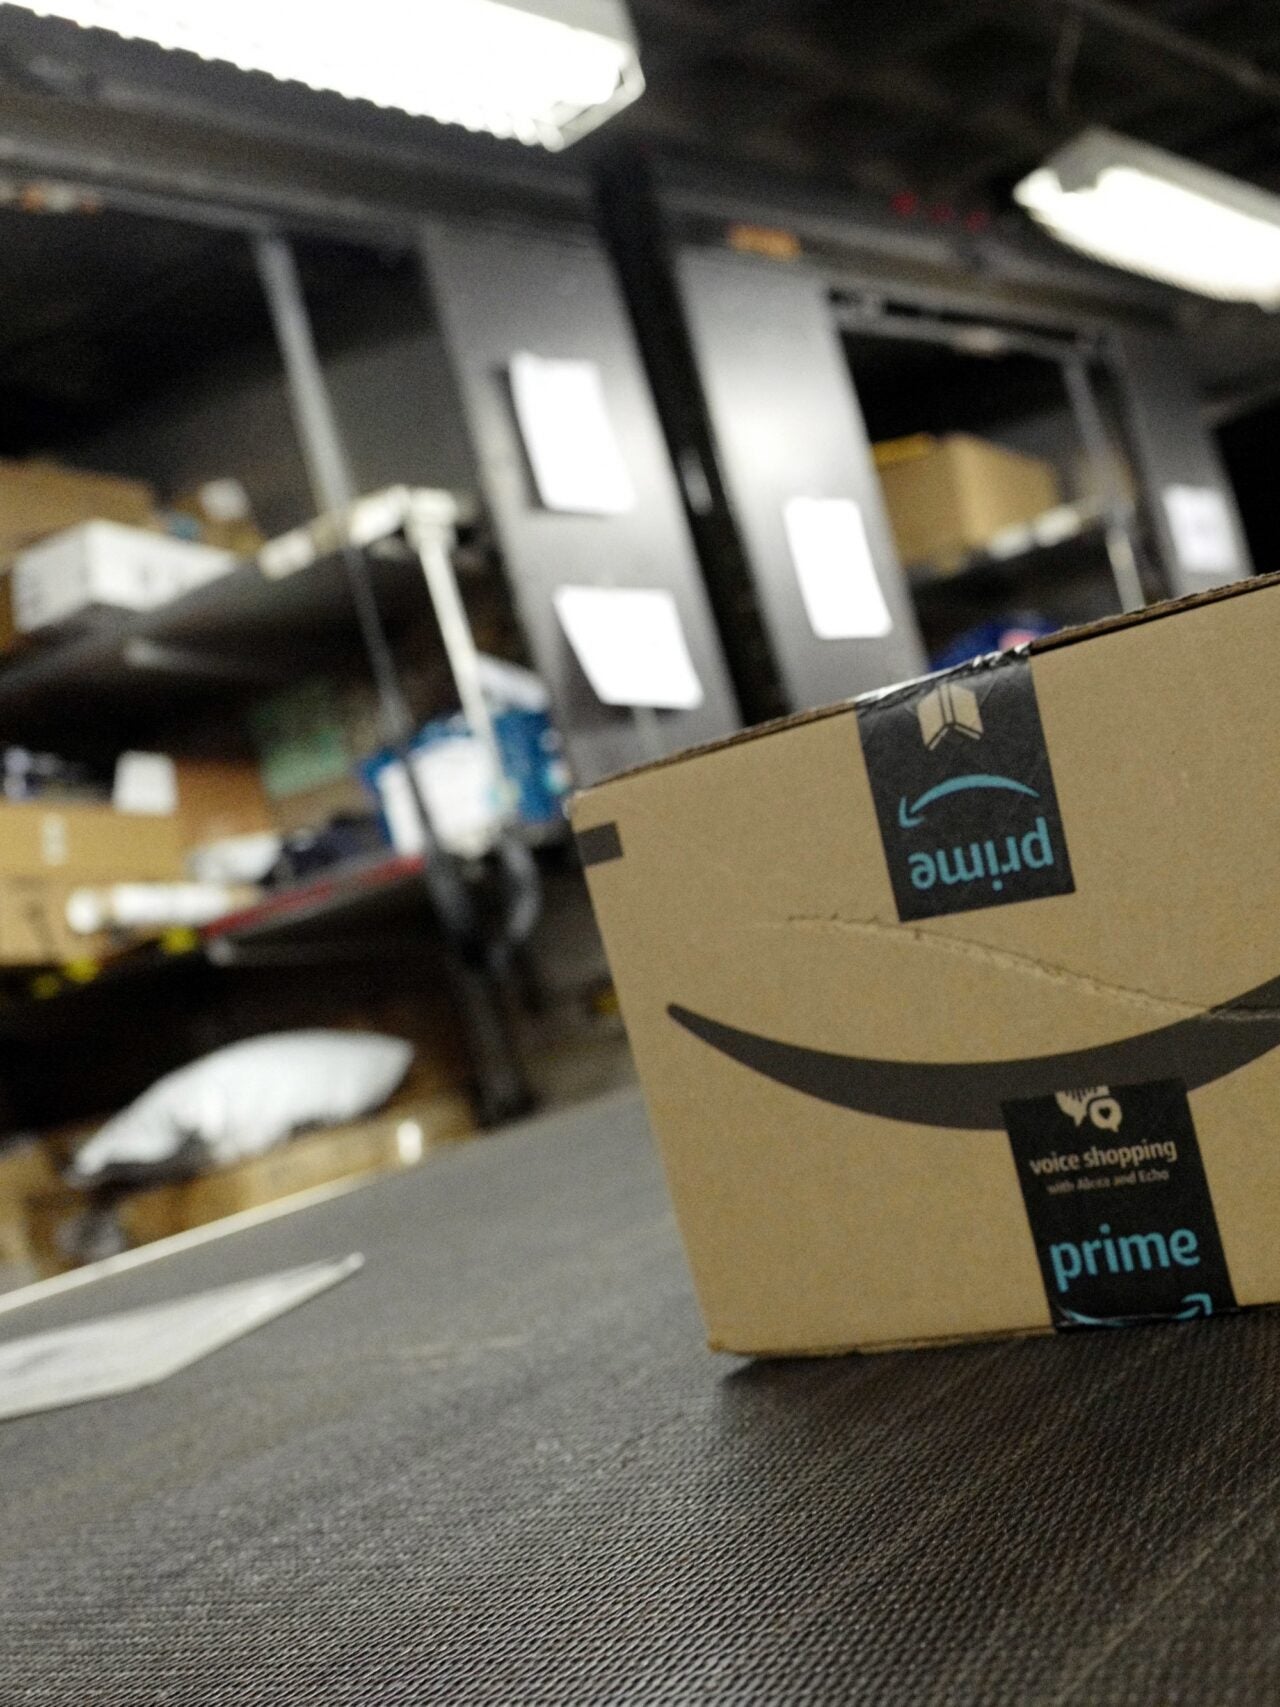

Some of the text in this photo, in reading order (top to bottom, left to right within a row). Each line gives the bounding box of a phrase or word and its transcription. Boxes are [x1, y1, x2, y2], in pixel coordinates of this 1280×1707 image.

[908, 816, 1055, 892] prime
[1029, 1139, 1178, 1175] voice shopping
[1138, 1168, 1170, 1184] Echo
[1050, 1223, 1201, 1293] prime
